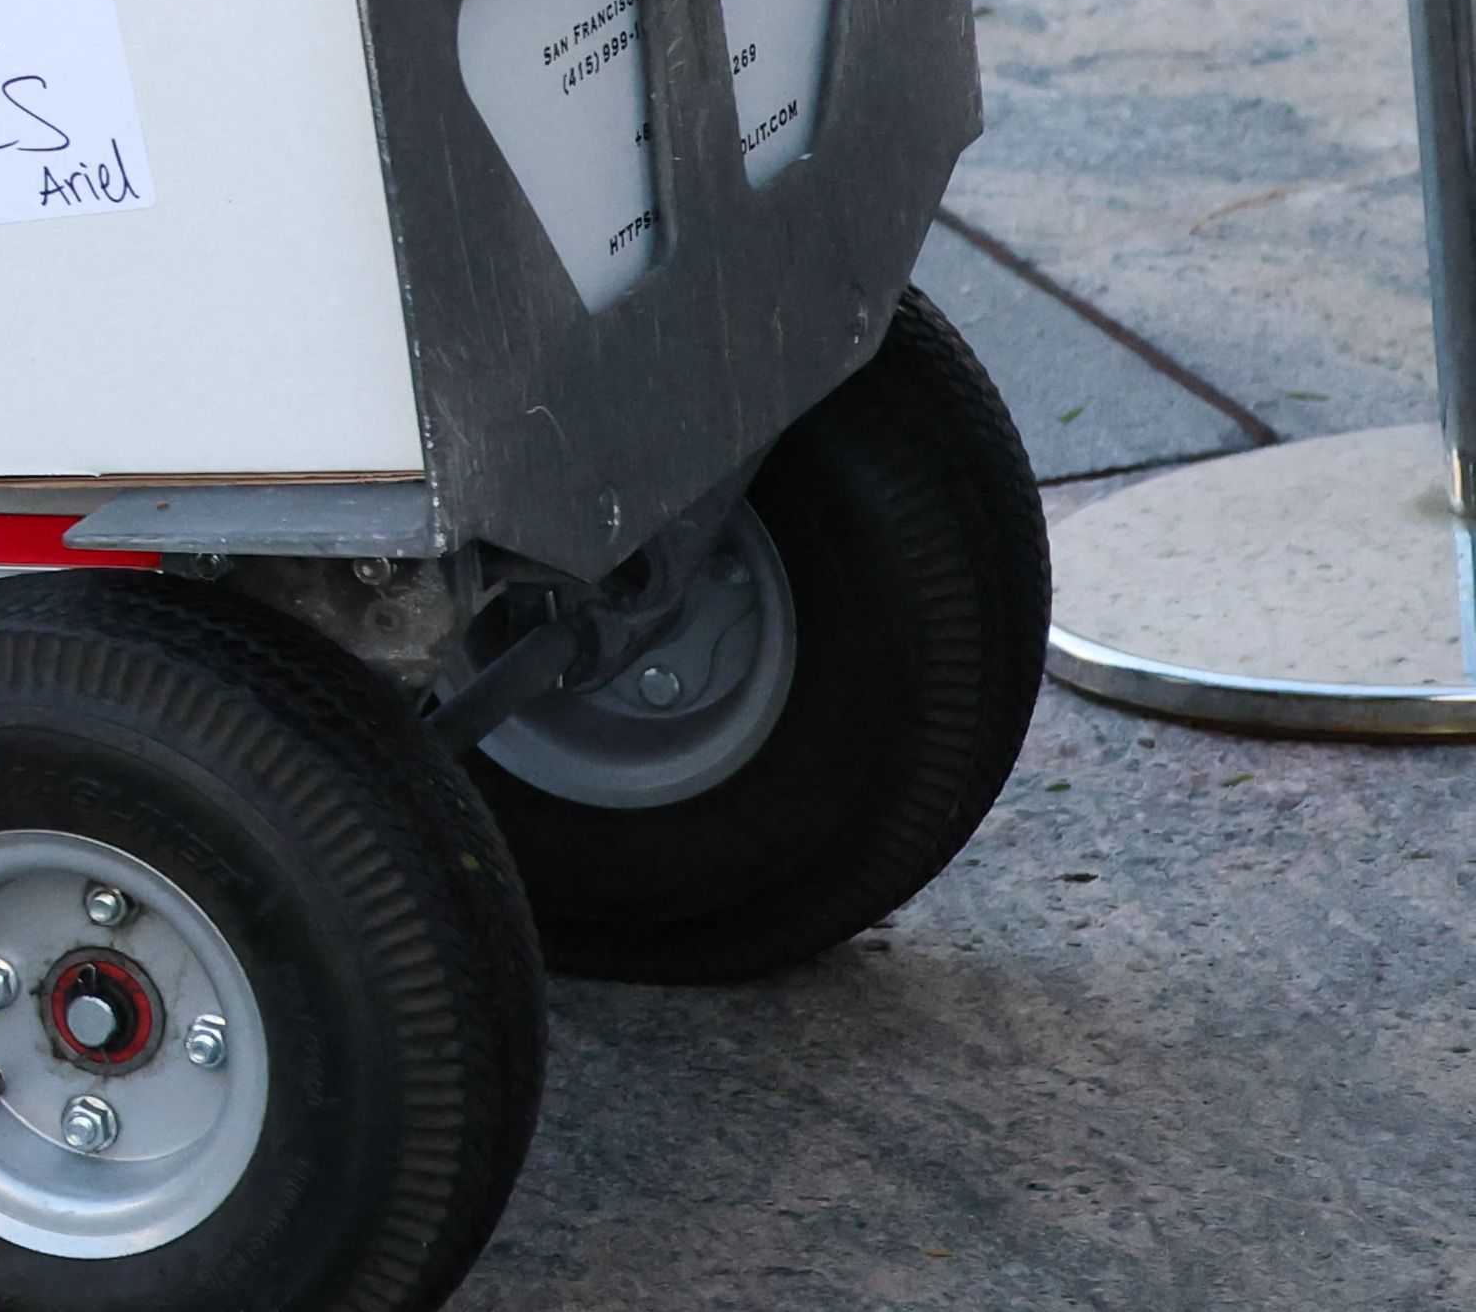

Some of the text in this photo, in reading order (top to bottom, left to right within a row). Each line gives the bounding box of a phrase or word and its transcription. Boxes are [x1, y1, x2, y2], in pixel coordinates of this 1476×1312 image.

[543, 36, 569, 66] SAN
[563, 22, 639, 95] (415) 999-1
[733, 44, 756, 75] 269
[610, 100, 799, 255] HTTPS OLIT.COM
